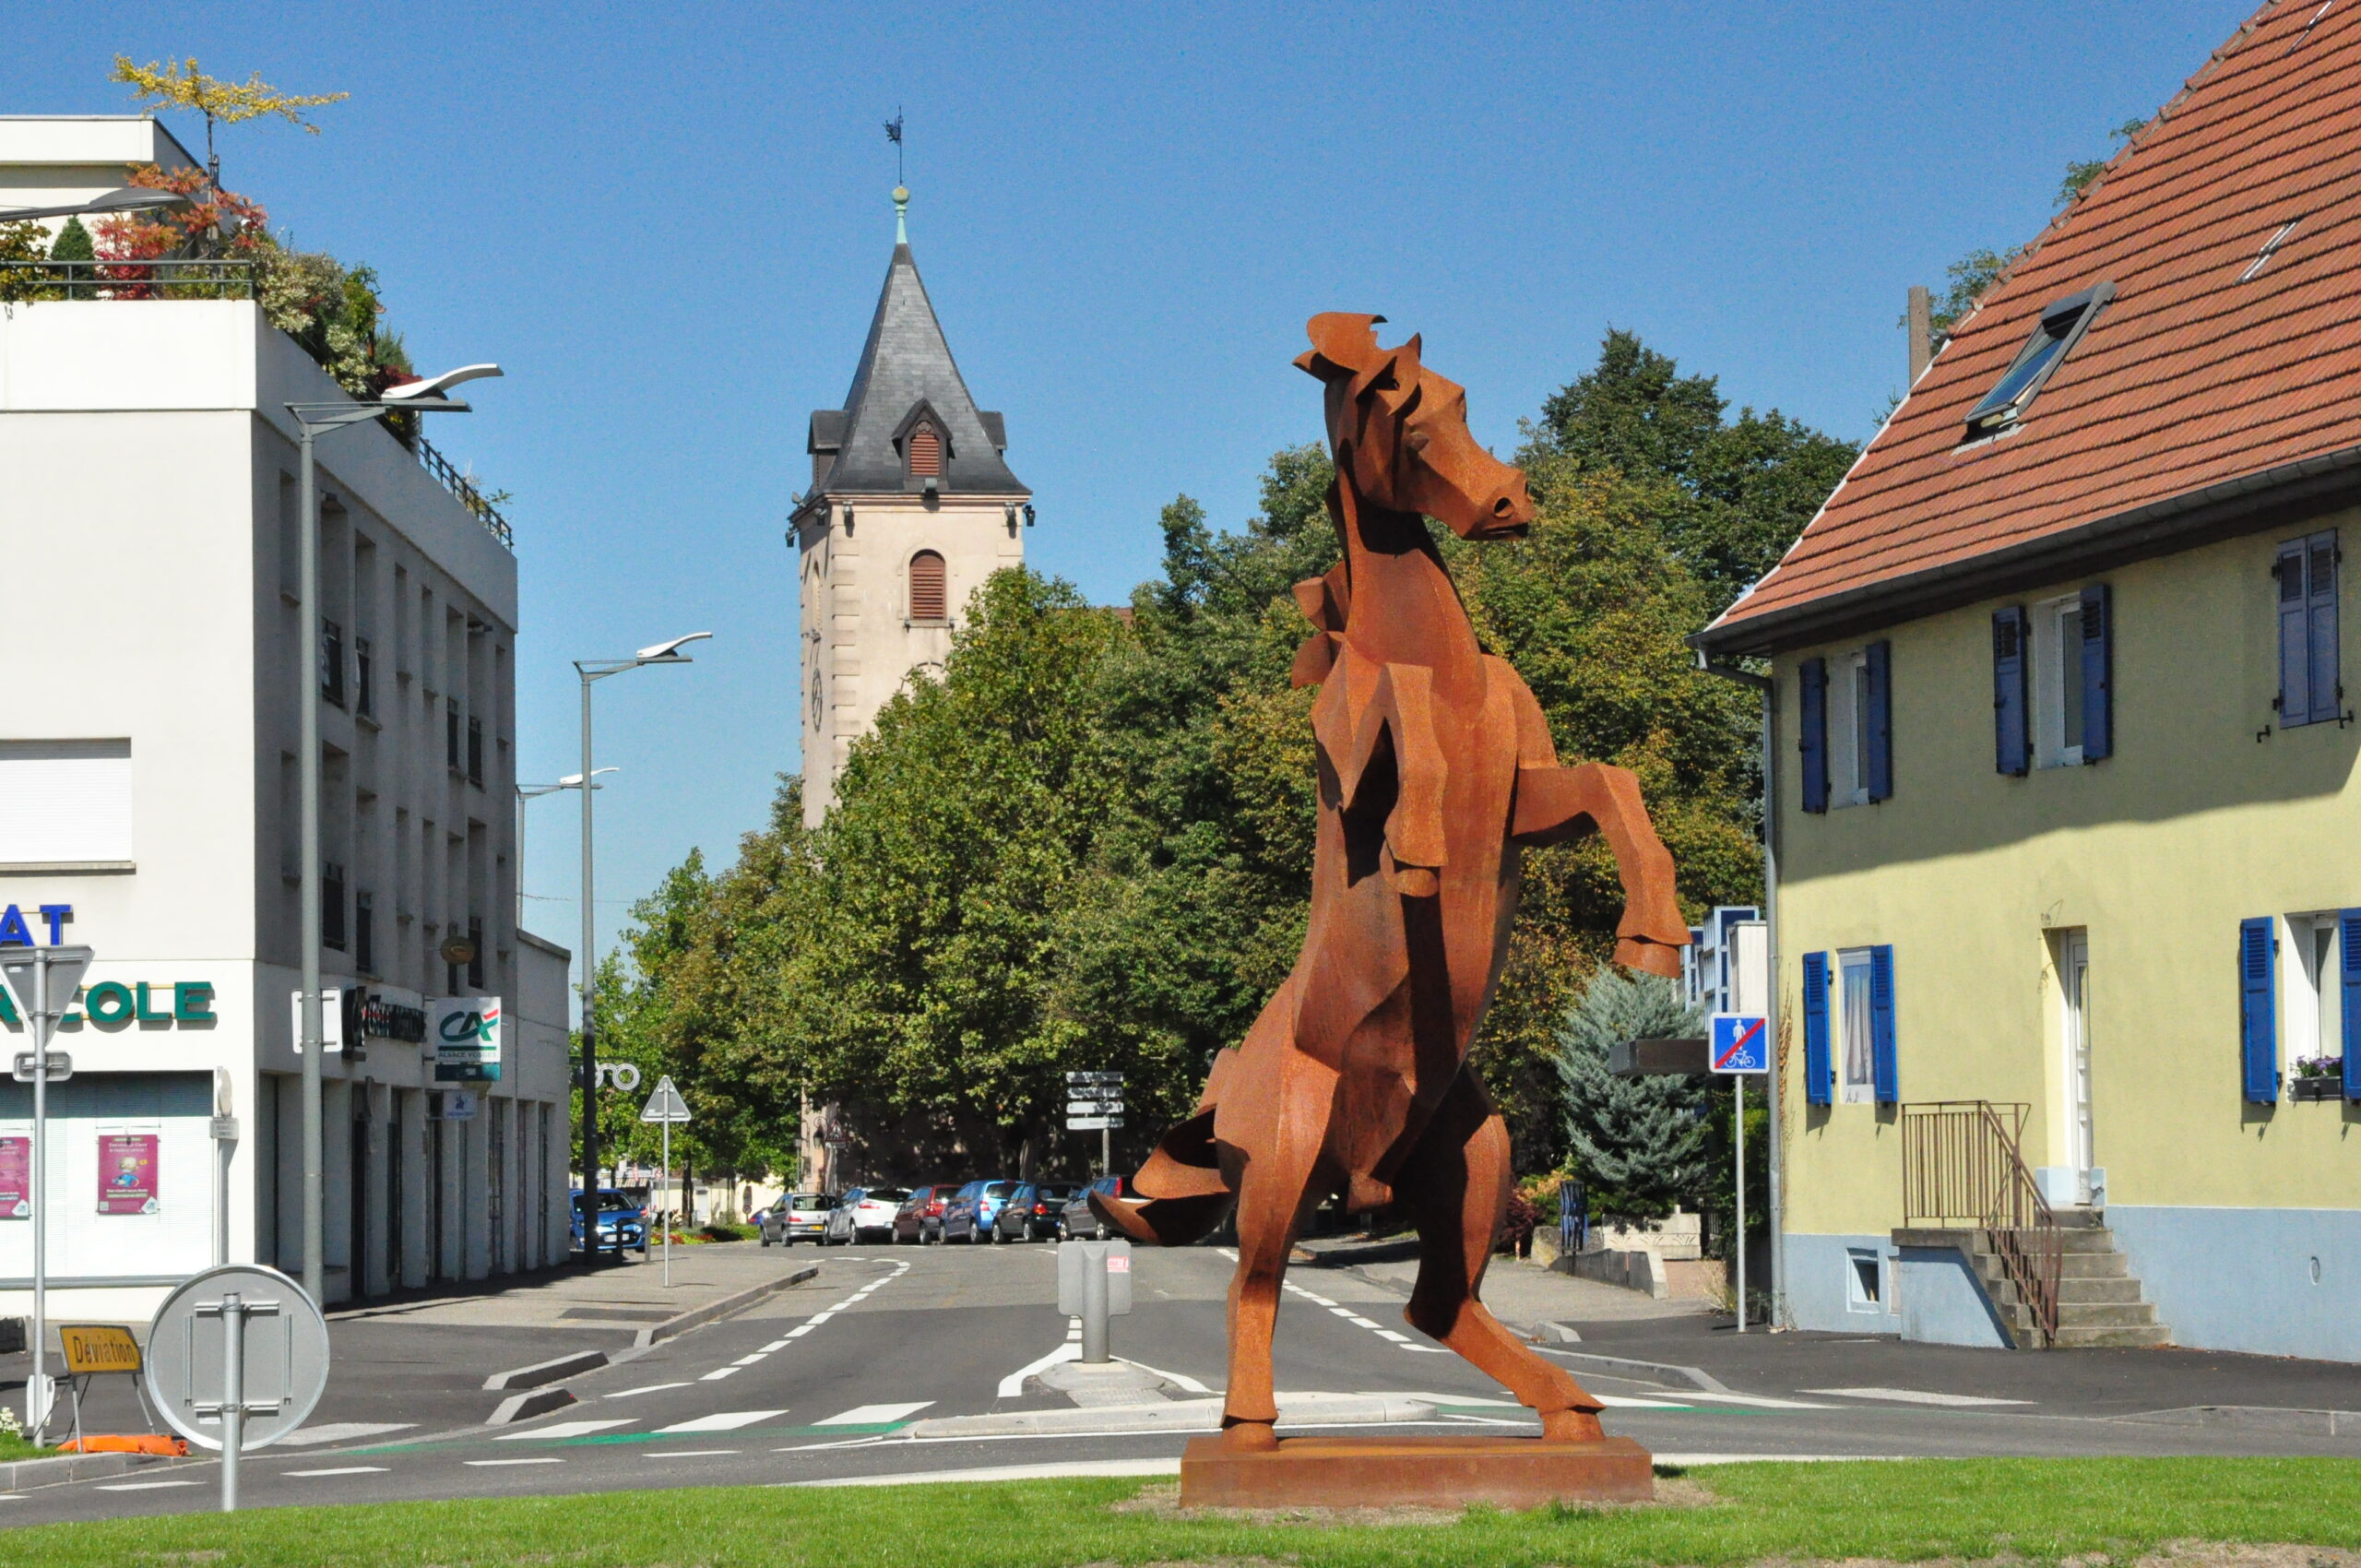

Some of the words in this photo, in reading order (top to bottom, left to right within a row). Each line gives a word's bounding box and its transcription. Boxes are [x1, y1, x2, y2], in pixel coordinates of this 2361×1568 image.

[0, 904, 71, 946] AT
[0, 981, 217, 1023] ROLE
[73, 1336, 136, 1363] Déviation
